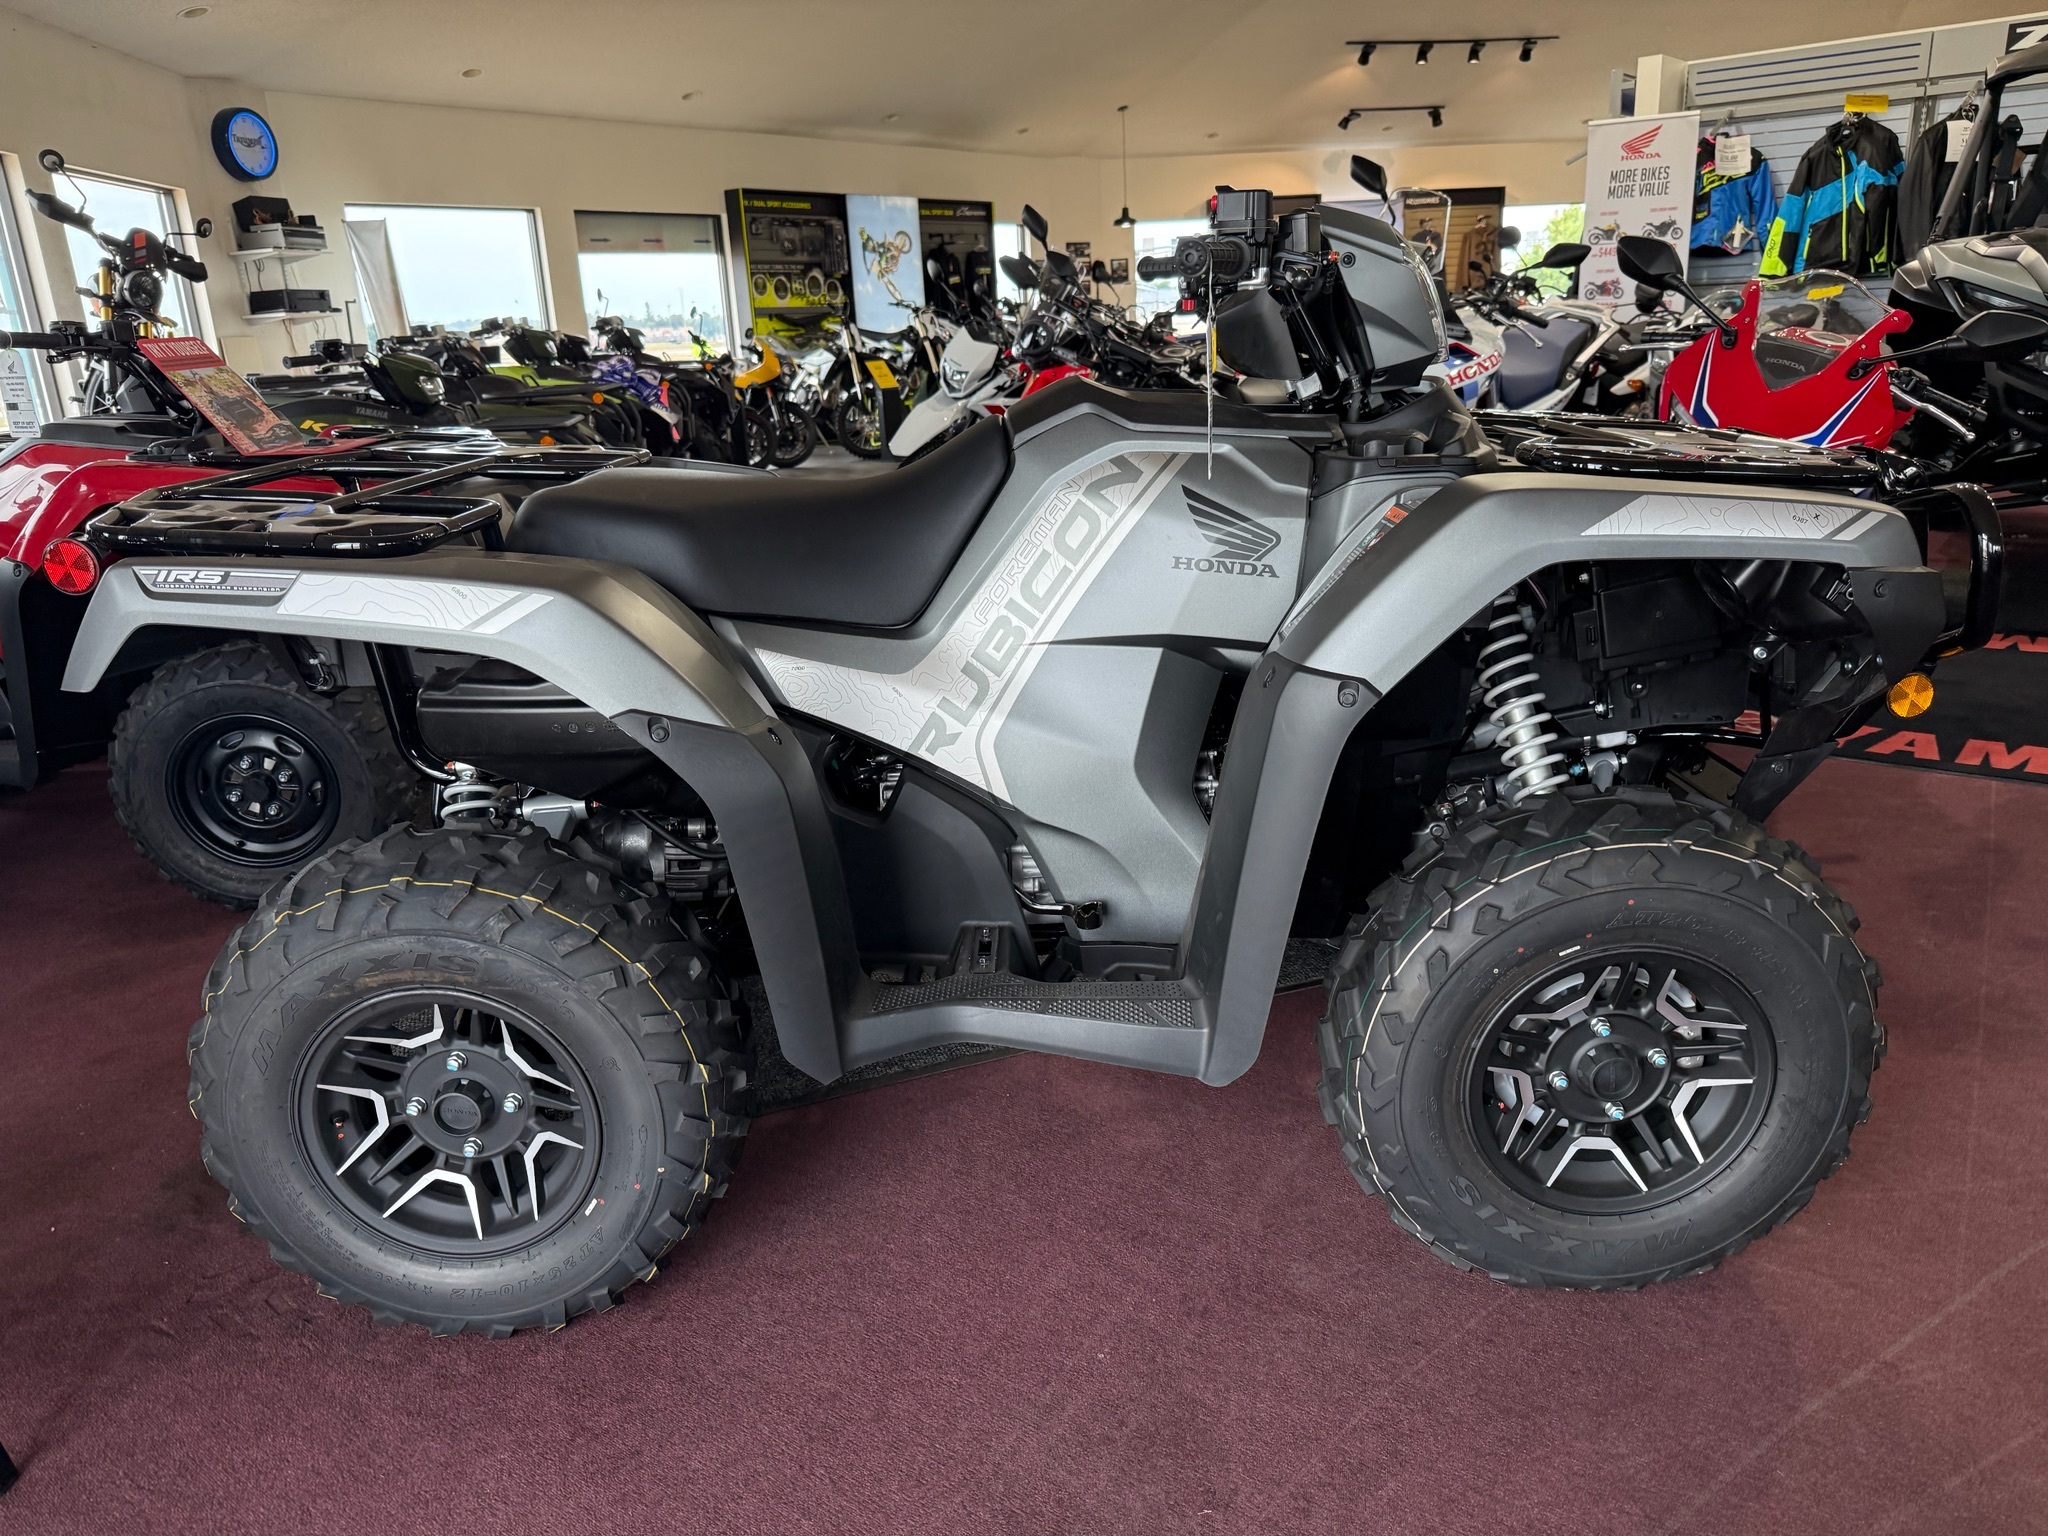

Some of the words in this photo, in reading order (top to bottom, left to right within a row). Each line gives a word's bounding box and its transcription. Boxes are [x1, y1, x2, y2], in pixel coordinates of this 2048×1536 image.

[231, 133, 263, 147] TRIUMPH
[1620, 152, 1662, 161] HONDA
[1609, 168, 1639, 185] MORE
[1640, 165, 1671, 182] BIKES
[1607, 183, 1637, 200] MORE
[1639, 181, 1671, 197] VALUE
[142, 343, 167, 358] TRY
[165, 340, 209, 357] YOURSELF
[1445, 350, 1504, 387] HONDA
[1764, 357, 1807, 373] HONDA
[355, 406, 389, 419] YAMAHA
[973, 477, 1082, 626] FOREMAN
[155, 569, 225, 584] IRS
[1171, 556, 1280, 579] HONDA
[906, 452, 1145, 757] RUBICON
[251, 952, 480, 1075] MAXXIS
[1446, 1174, 1696, 1258] MAXXIS
